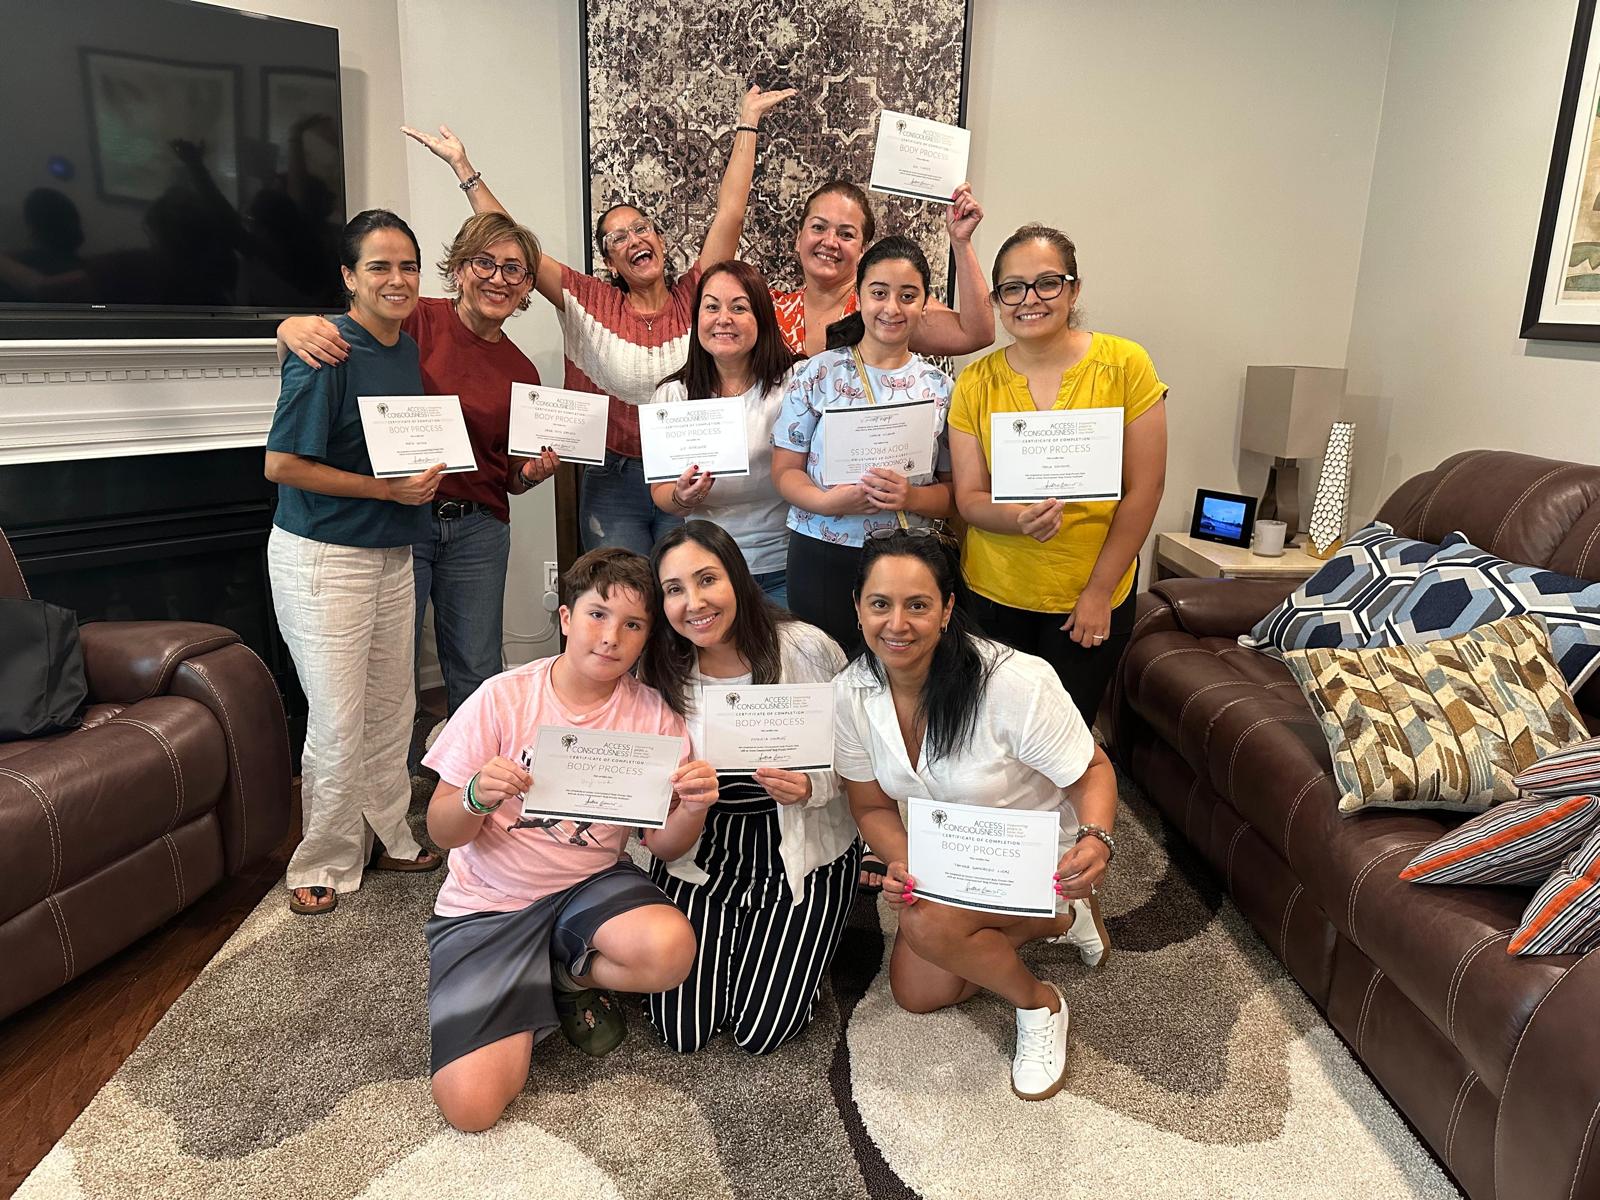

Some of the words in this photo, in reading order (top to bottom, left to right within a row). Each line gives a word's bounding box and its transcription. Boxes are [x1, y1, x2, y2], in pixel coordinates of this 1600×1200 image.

[923, 130, 942, 138] ACC
[920, 149, 948, 160] PROCE
[1024, 429, 1075, 437] CONSCIOUSNESS
[1022, 445, 1048, 455] BODY
[1050, 444, 1091, 454] PROCESS
[736, 719, 762, 728] BODY
[764, 717, 805, 726] PROCESS
[572, 746, 629, 757] CONSCIOUSNESS
[567, 762, 596, 771] BODY
[598, 765, 644, 776] PROCESS
[944, 824, 1002, 837] CONSCIOUSNESS
[974, 820, 1003, 830] ACCESS
[942, 833, 974, 841] CERTIFICATE
[942, 841, 971, 852] BODY
[974, 845, 1021, 858] PROCESS
